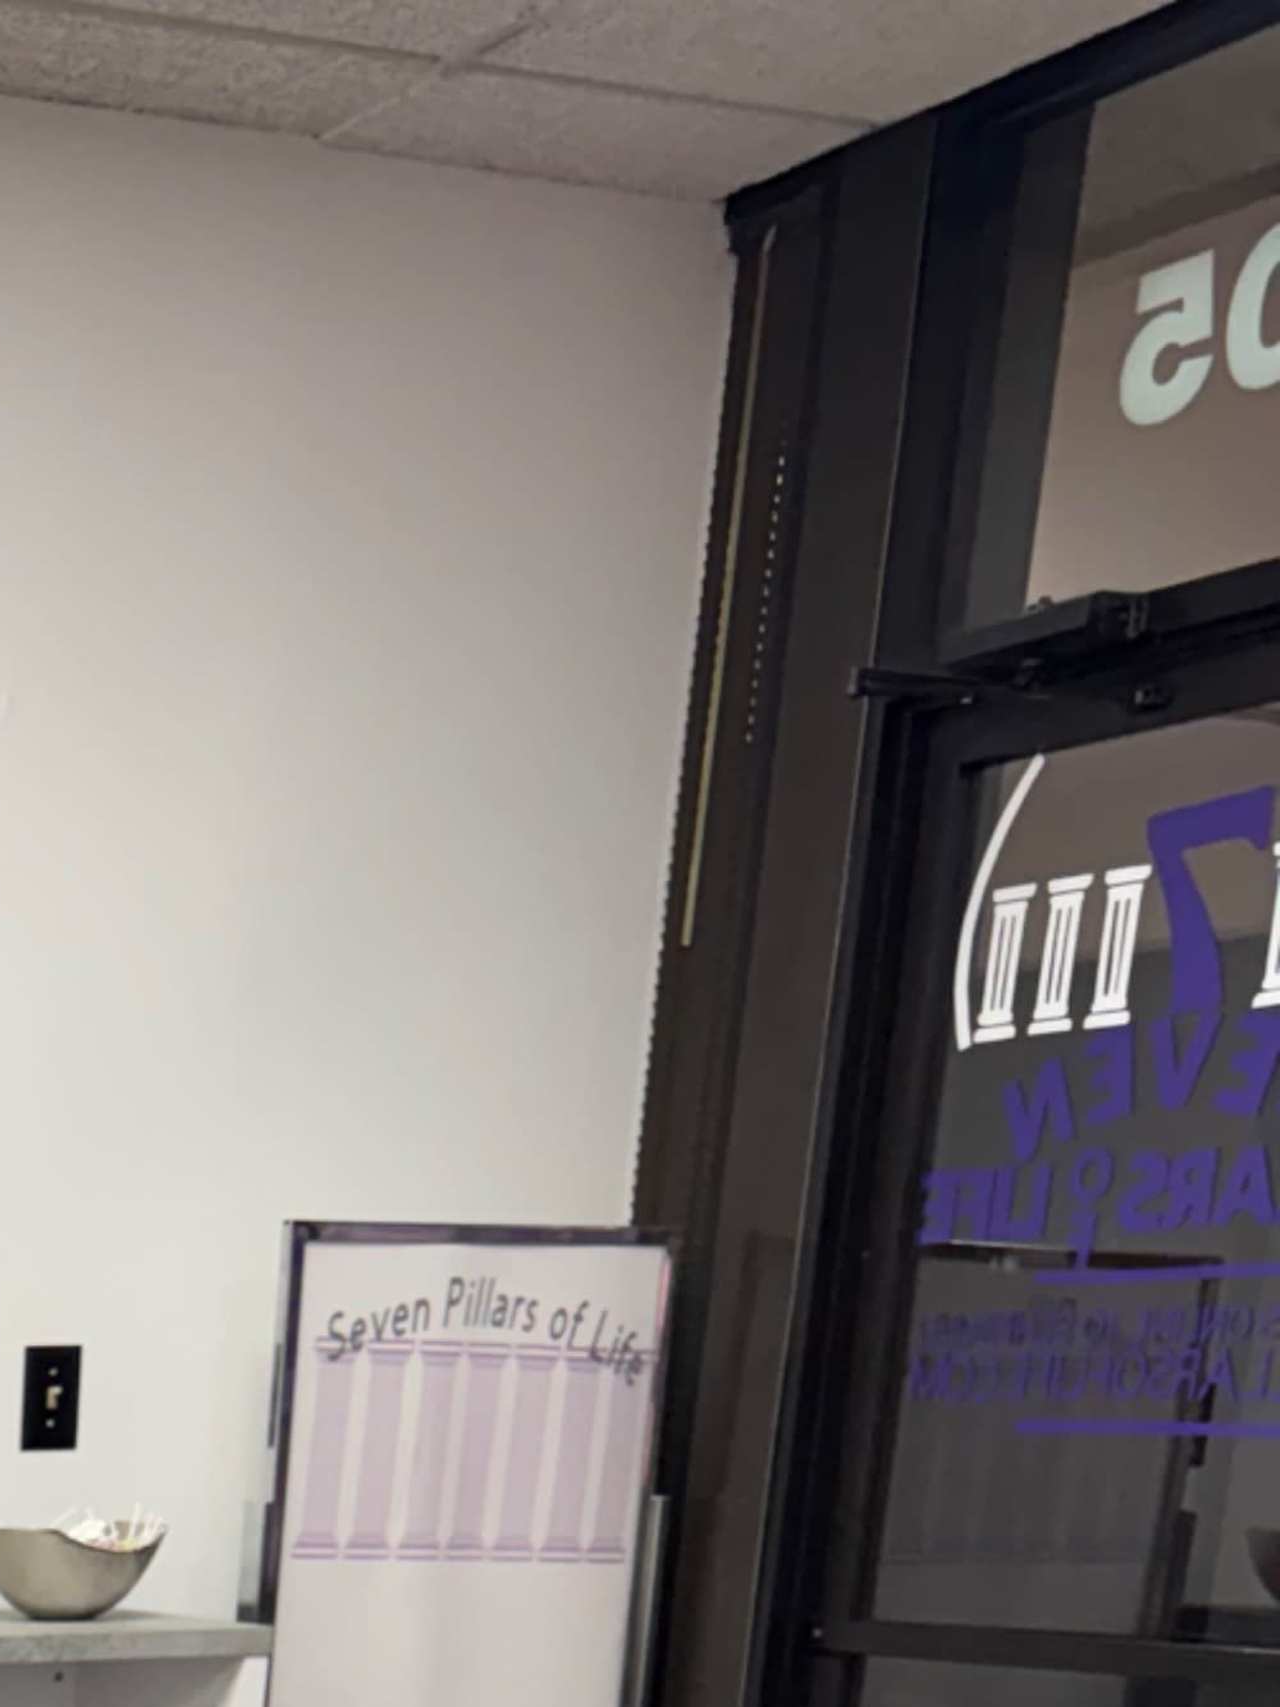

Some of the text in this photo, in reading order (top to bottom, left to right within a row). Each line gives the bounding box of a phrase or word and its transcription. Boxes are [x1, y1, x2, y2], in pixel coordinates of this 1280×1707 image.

[326, 1275, 646, 1387] Seven Pillars of Life
